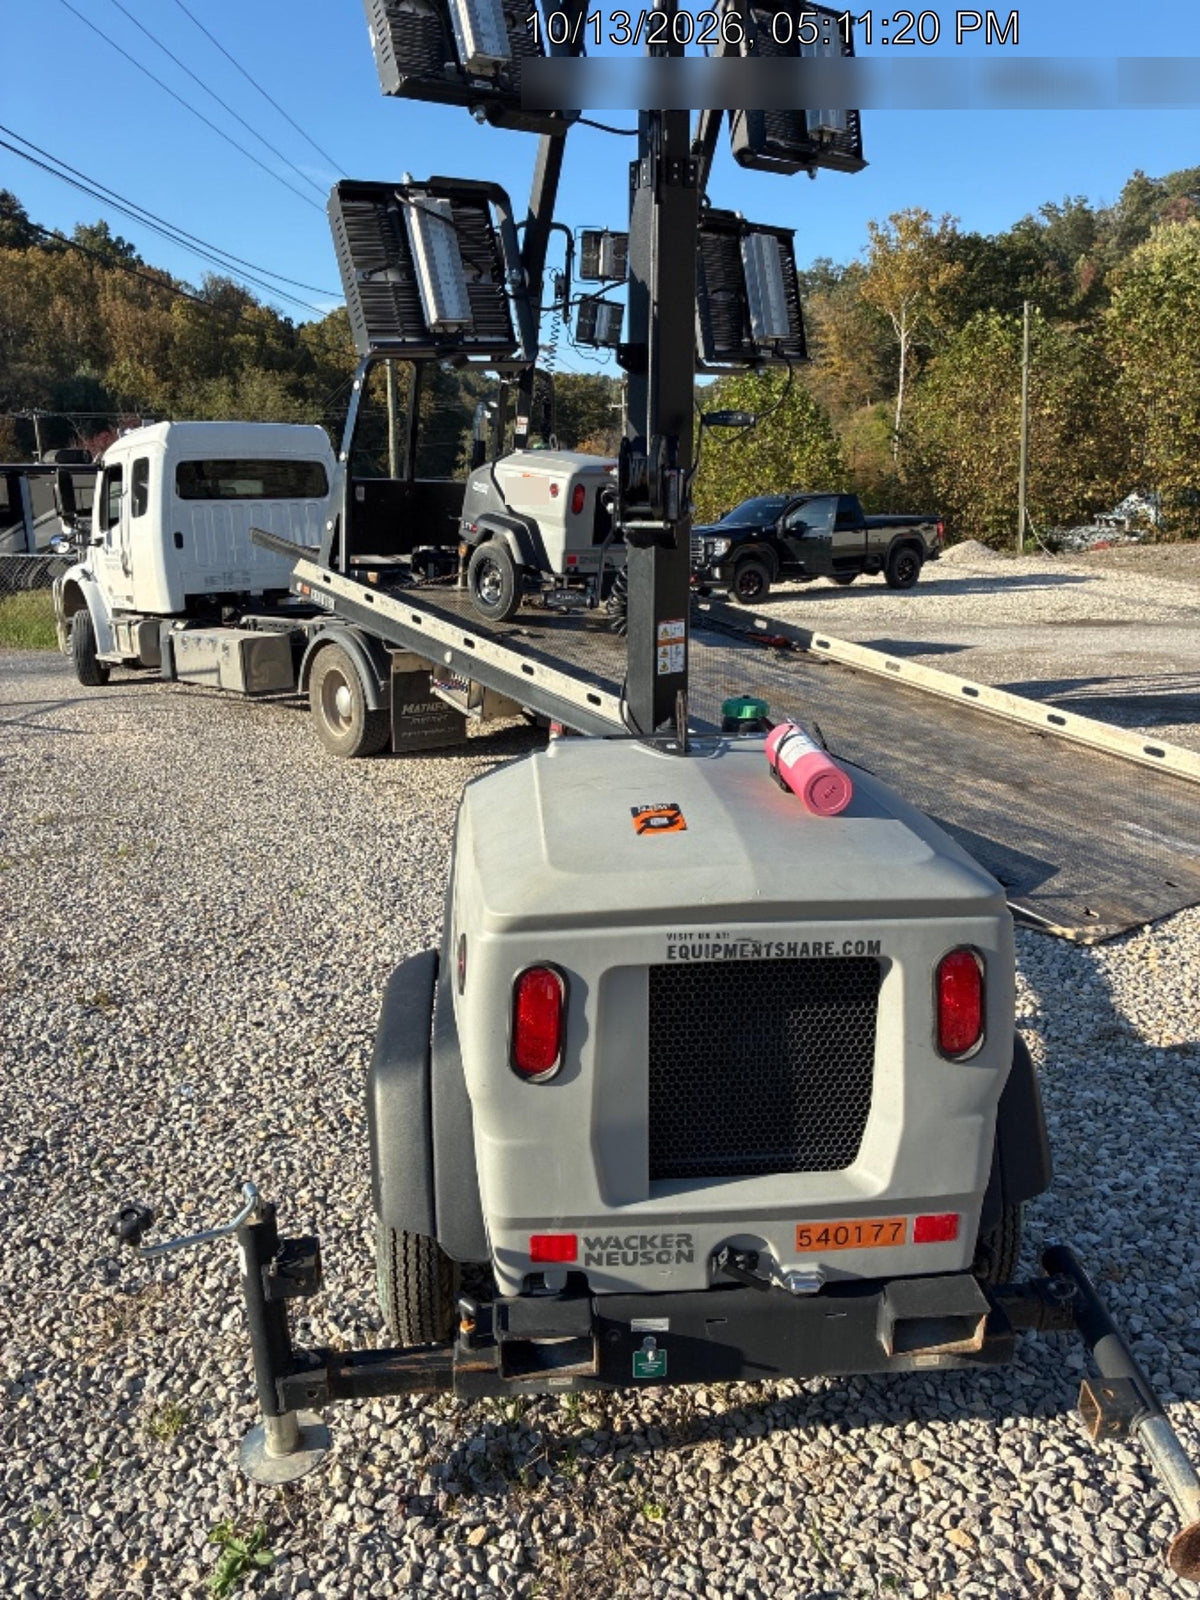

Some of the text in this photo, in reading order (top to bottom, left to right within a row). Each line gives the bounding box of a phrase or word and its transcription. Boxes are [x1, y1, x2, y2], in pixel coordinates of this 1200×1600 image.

[666, 932, 694, 941] VISIT
[667, 939, 881, 960] EQUIPMENTSHARE.COM
[583, 1233, 694, 1250] WACKER
[798, 1222, 903, 1247] 540177
[584, 1249, 694, 1267] NEUSON
